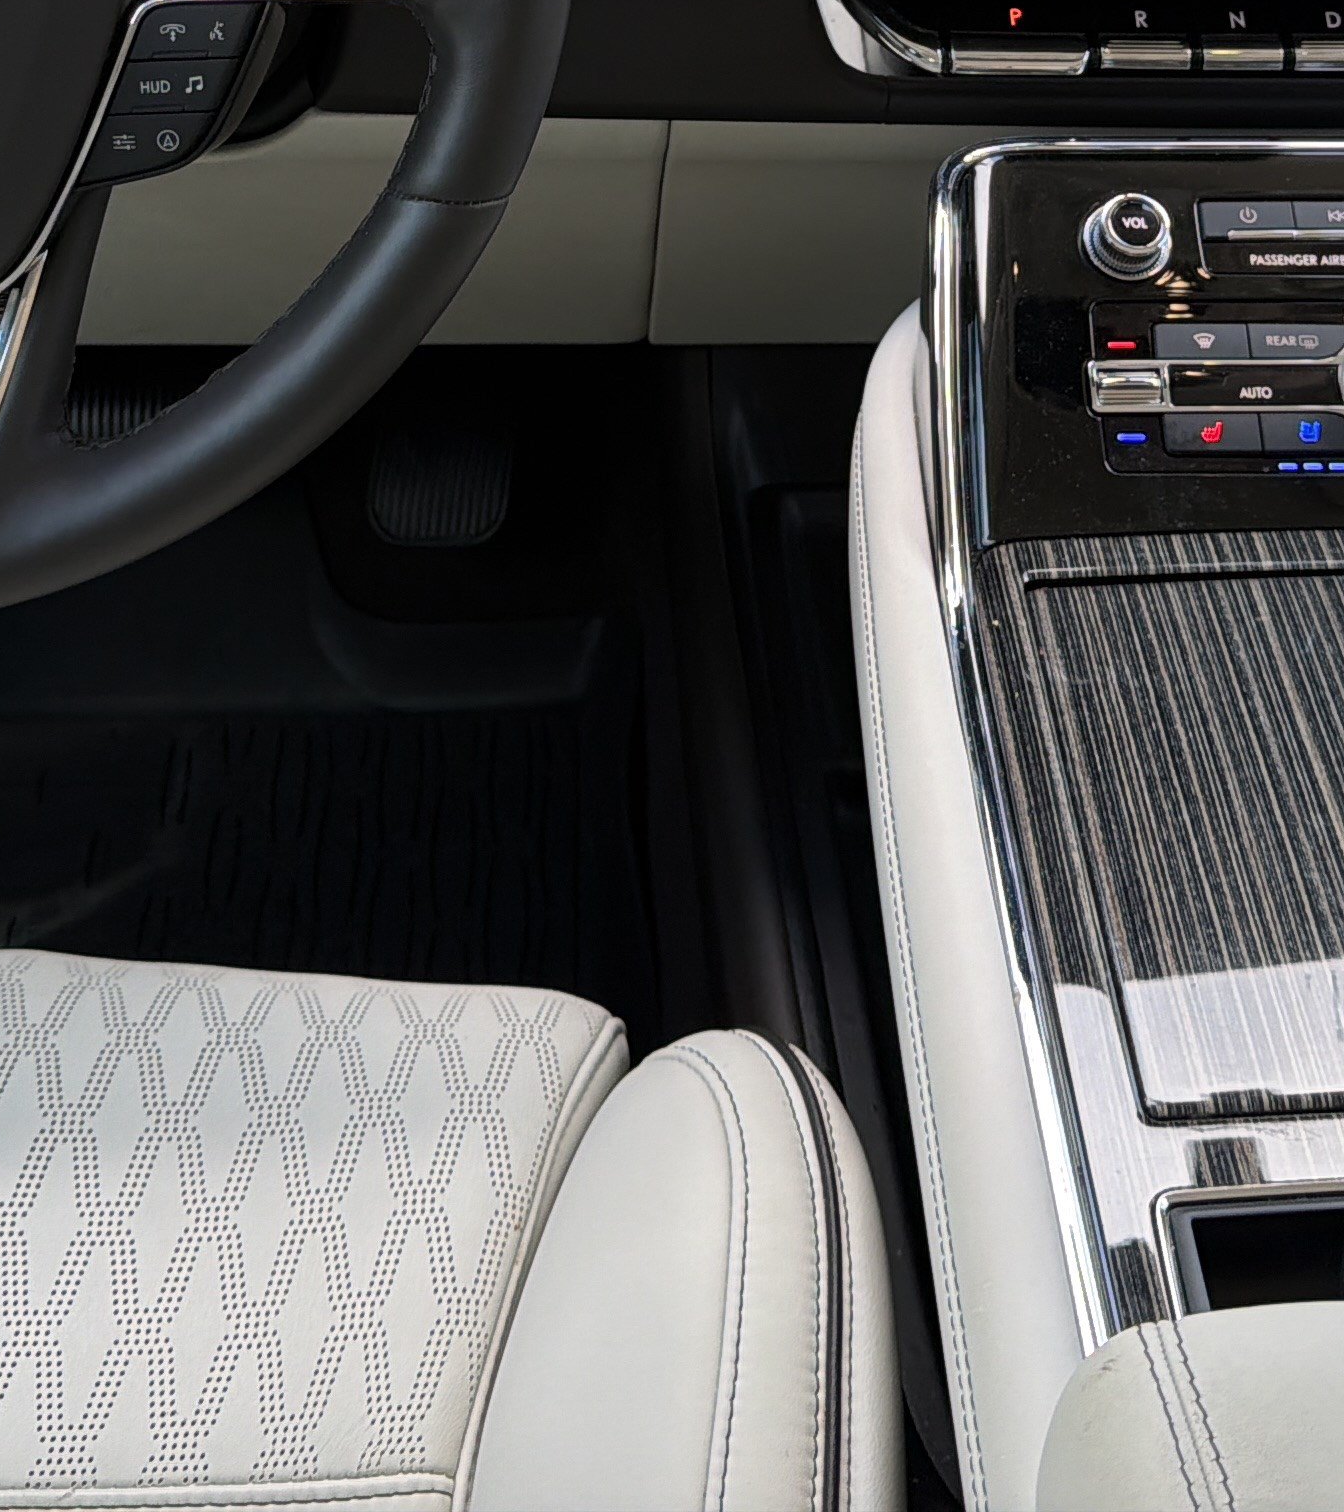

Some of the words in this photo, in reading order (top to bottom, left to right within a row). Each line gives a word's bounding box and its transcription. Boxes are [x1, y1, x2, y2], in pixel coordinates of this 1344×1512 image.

[1009, 8, 1023, 26] P
[1134, 10, 1148, 28] R
[1228, 10, 1247, 29] N
[1325, 10, 1342, 29] D
[140, 80, 171, 94] HUD
[1122, 215, 1148, 230] VOL
[1250, 253, 1318, 267] PASSENGER
[1265, 334, 1297, 347] REAR
[1239, 386, 1273, 399] AUTO
